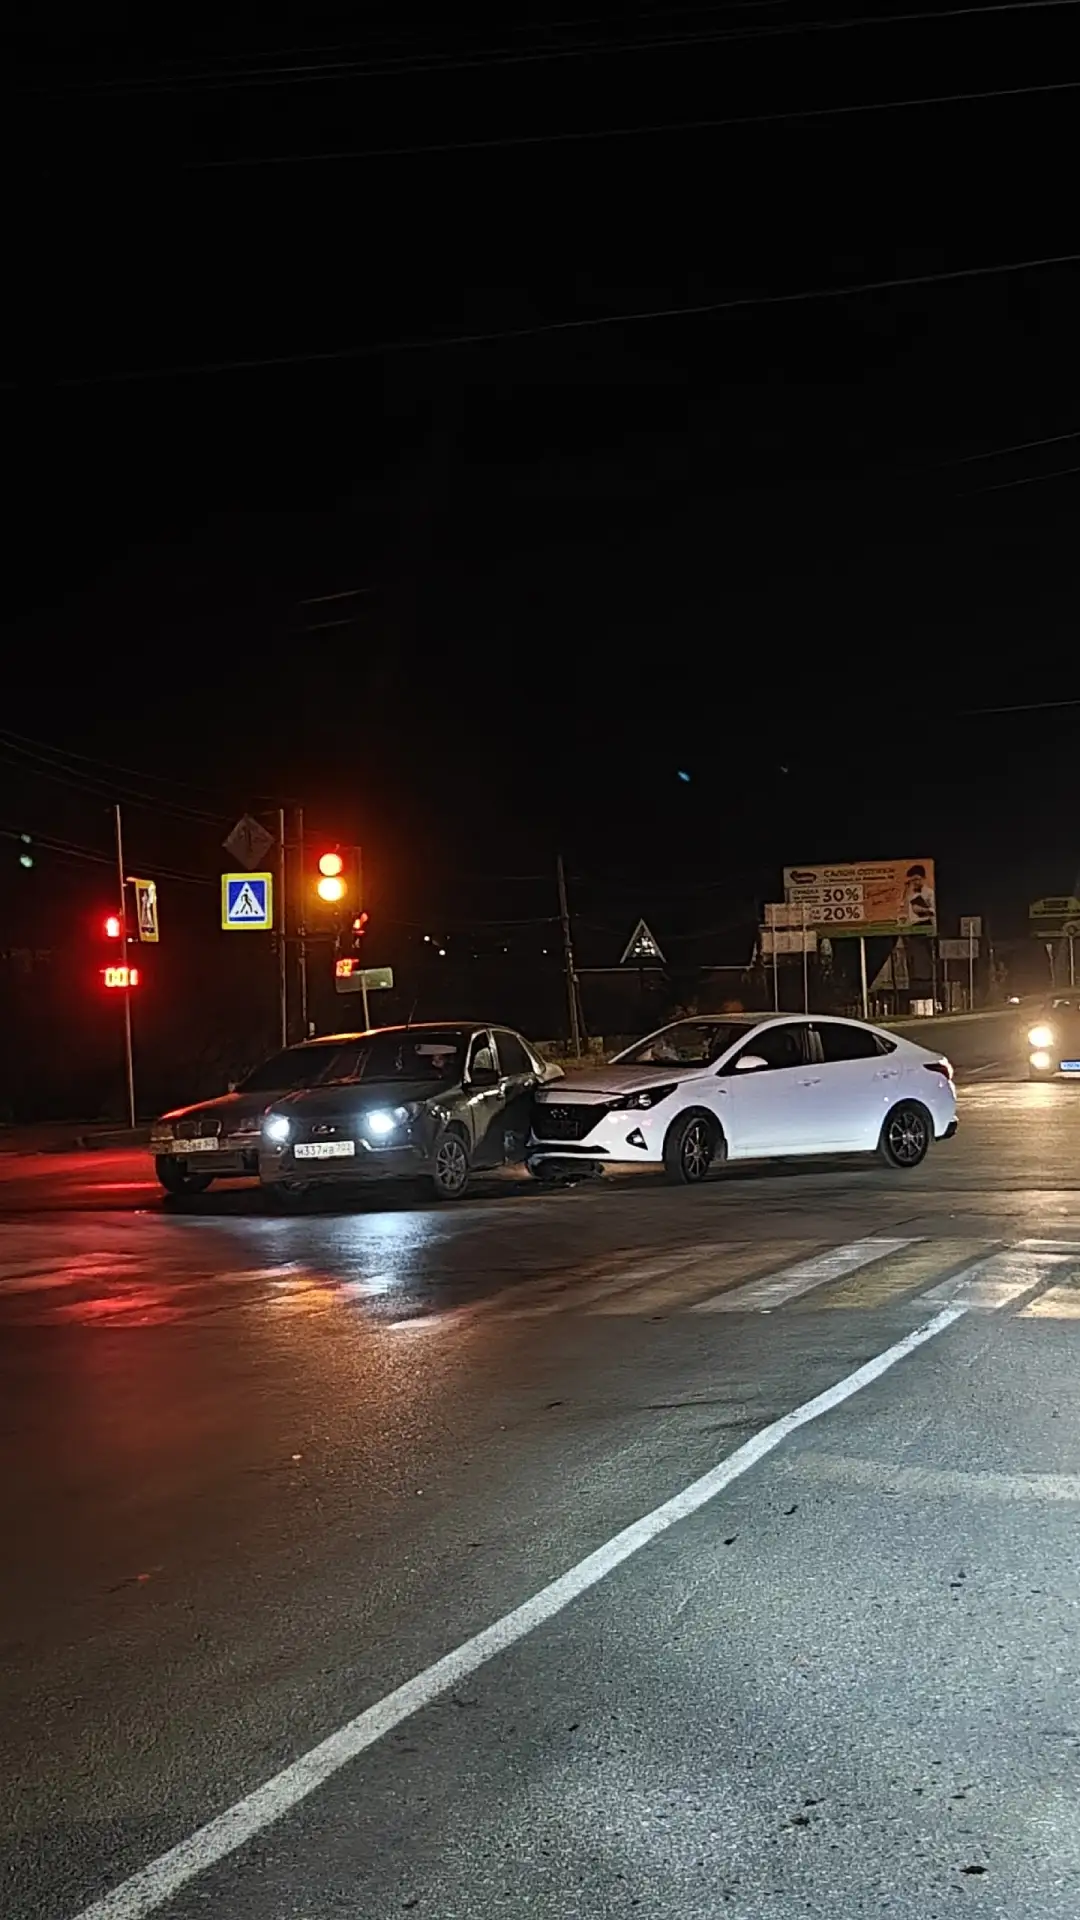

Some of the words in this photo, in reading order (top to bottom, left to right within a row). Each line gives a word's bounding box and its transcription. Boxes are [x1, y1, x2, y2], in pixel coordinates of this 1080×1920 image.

[823, 869, 856, 877] САЛОН
[823, 887, 859, 902] 30%
[823, 906, 860, 921] 20%
